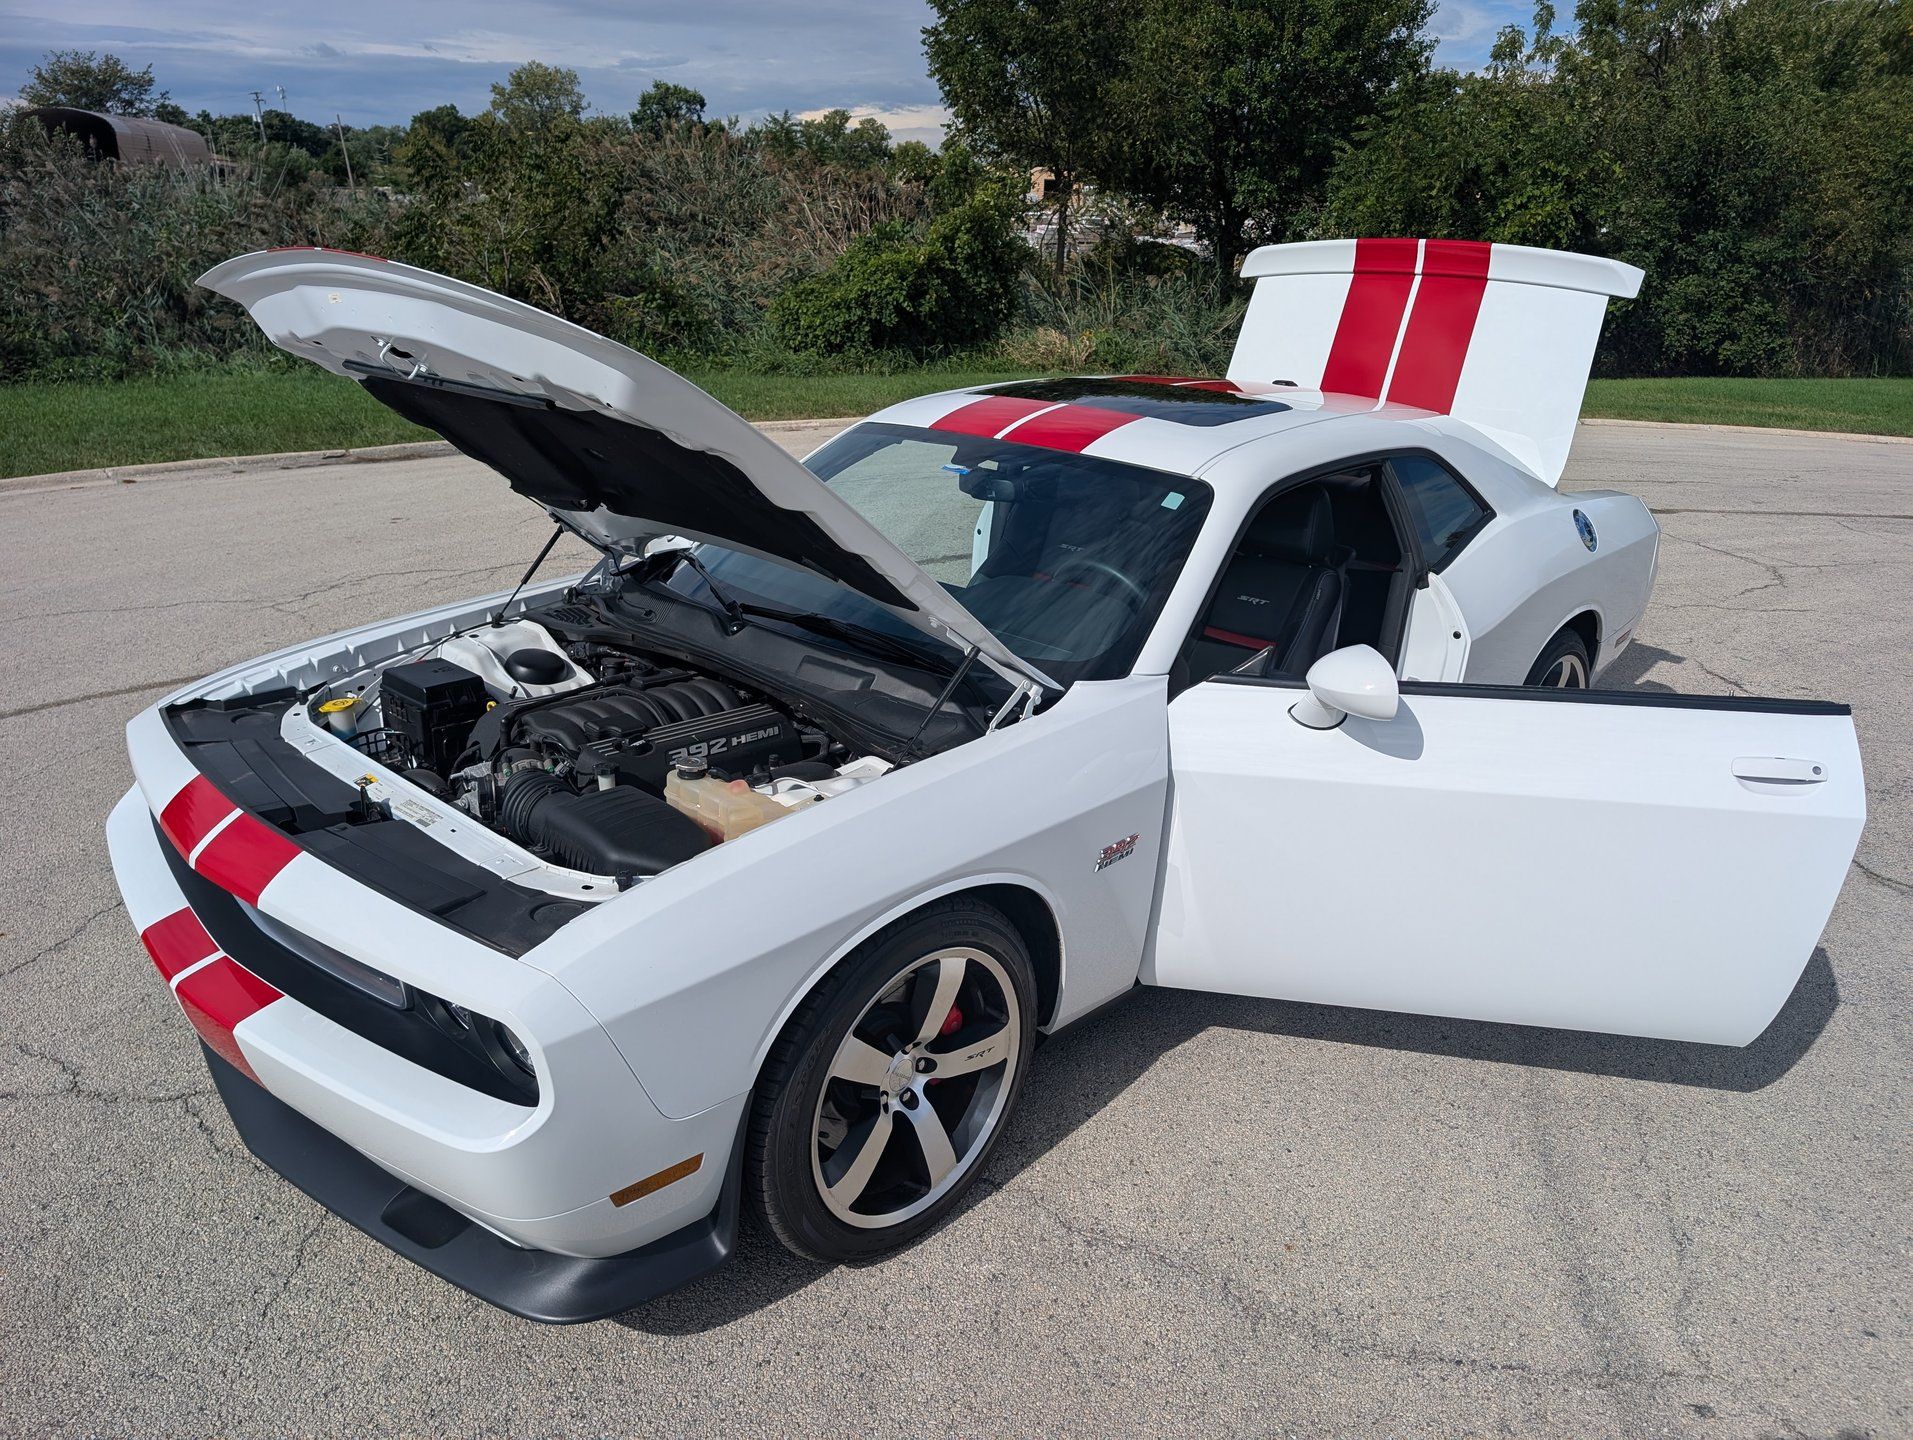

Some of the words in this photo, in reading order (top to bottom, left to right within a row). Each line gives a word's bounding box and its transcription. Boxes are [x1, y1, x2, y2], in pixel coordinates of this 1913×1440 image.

[1237, 595, 1270, 605] SRT
[668, 737, 728, 766] 392
[731, 726, 780, 747] HEMI
[964, 1045, 995, 1061] SRT
